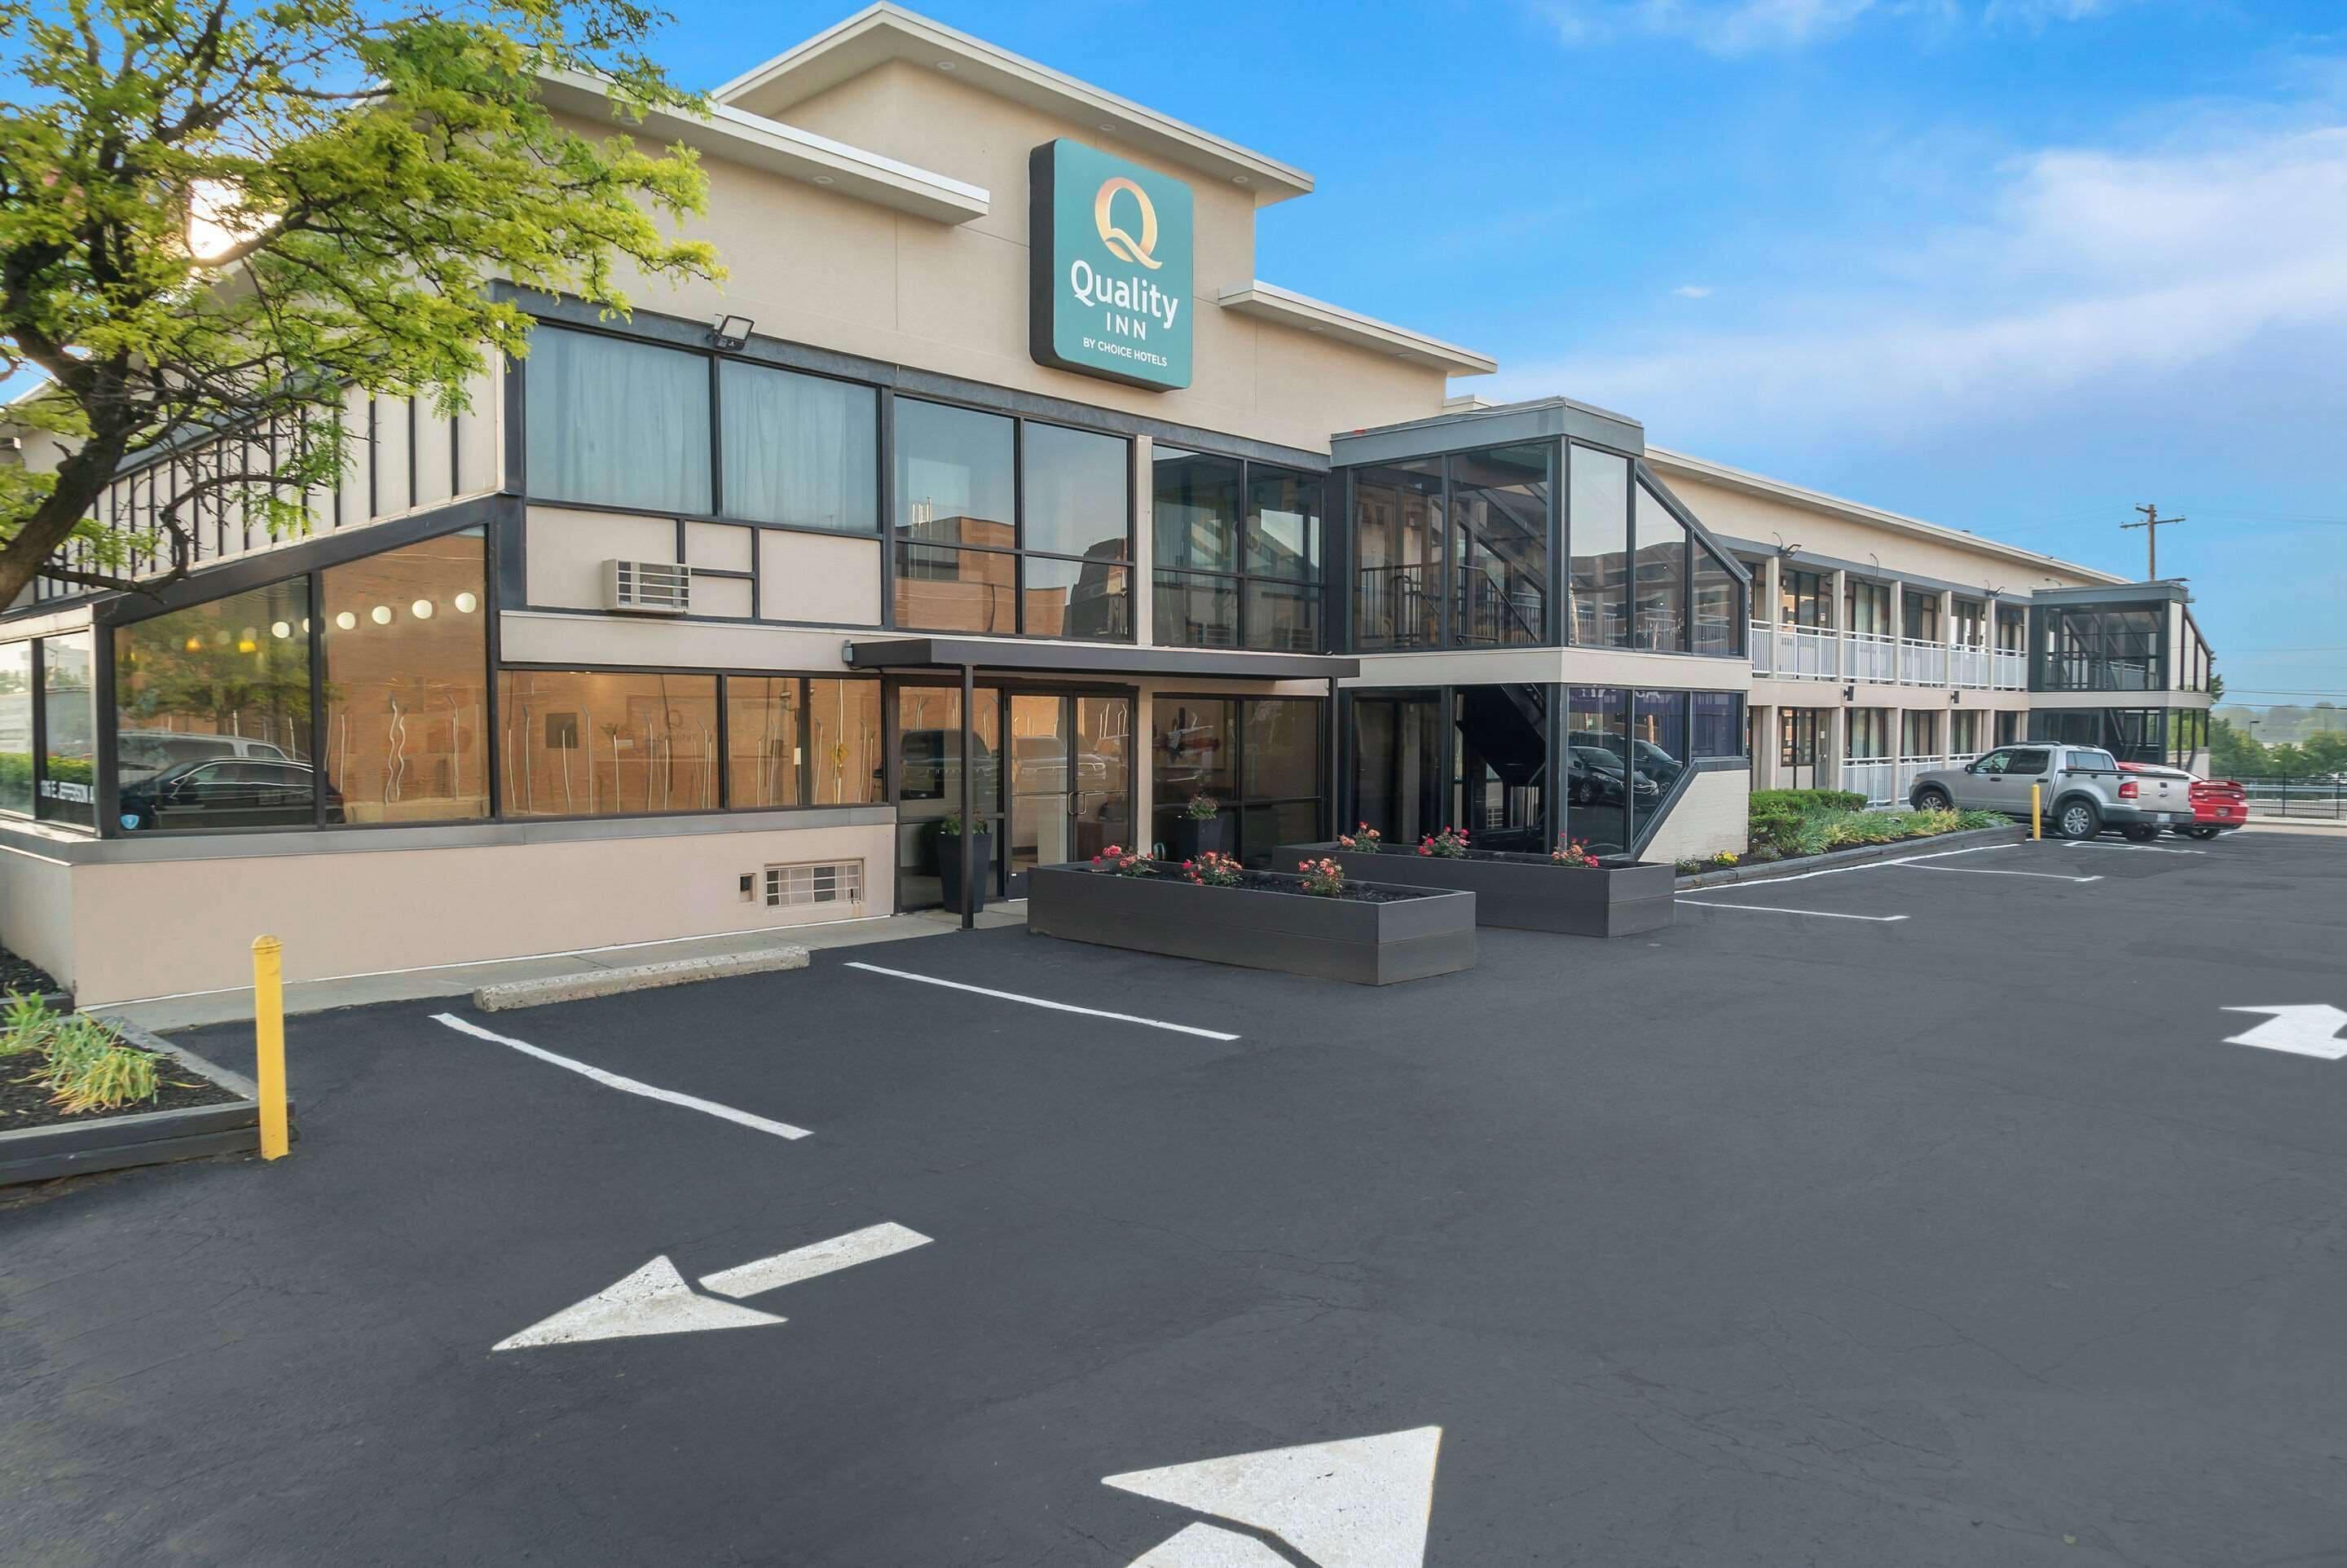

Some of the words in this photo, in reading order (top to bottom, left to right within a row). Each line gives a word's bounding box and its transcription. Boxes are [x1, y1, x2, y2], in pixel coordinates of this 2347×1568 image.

[1094, 177, 1163, 270] Q
[1071, 260, 1178, 329] Quality
[1107, 312, 1146, 341] INN
[1083, 337, 1095, 349] BY
[1098, 341, 1132, 358] CHOICE
[1134, 350, 1167, 367] HOTELS
